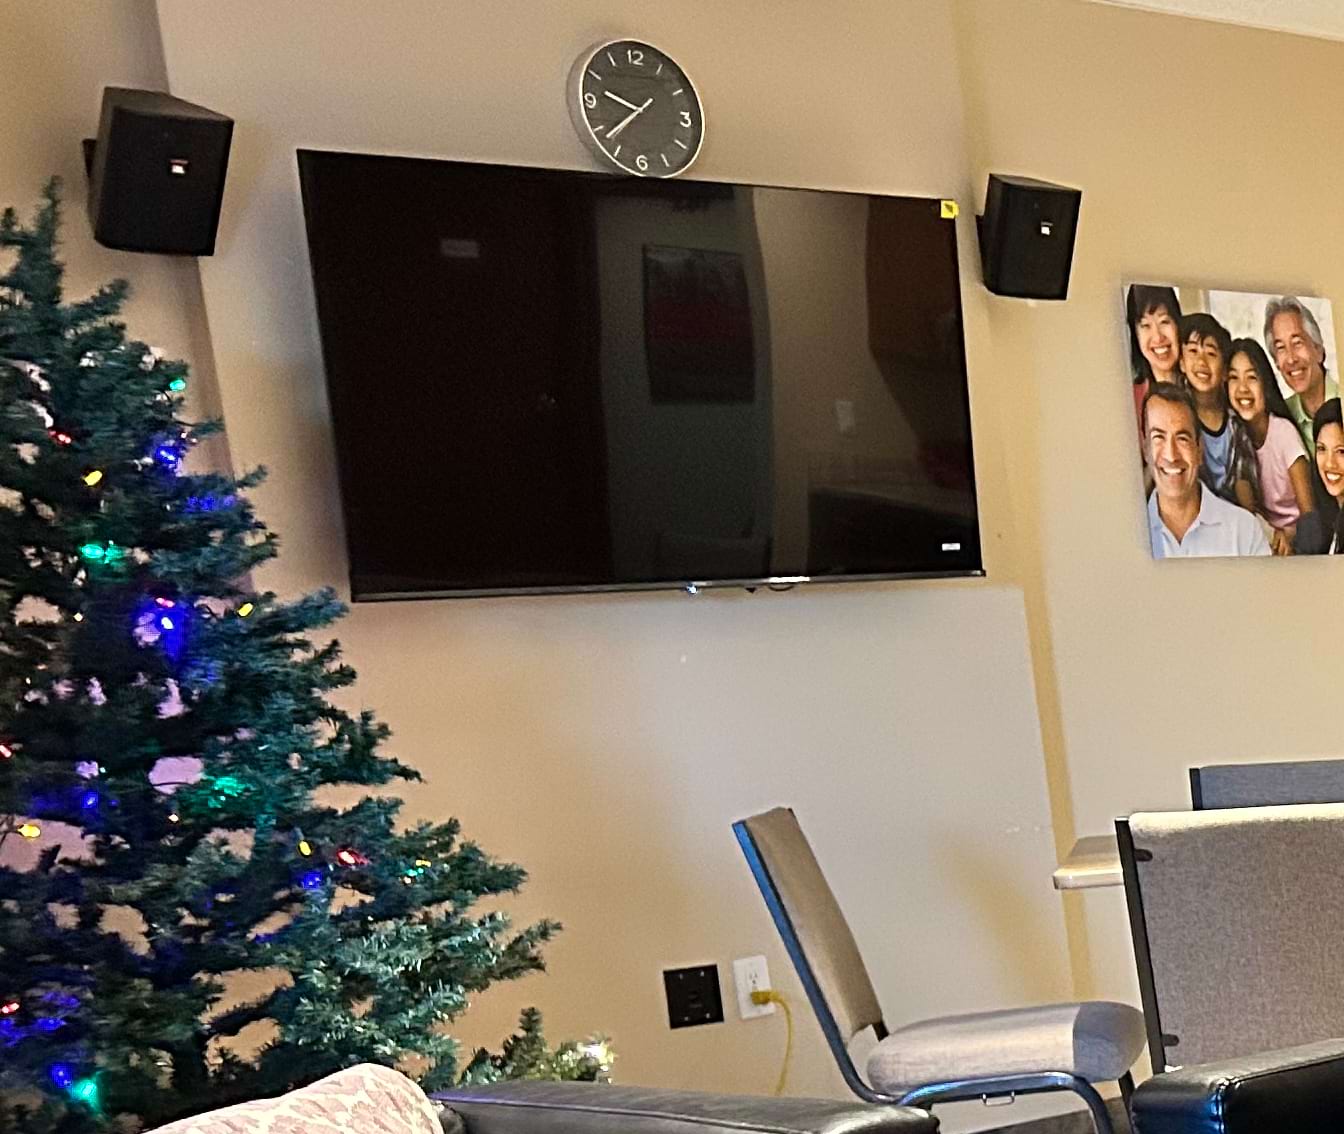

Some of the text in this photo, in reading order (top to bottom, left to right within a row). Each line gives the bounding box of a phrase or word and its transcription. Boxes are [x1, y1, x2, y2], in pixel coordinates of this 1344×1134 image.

[626, 49, 644, 66] 12
[583, 92, 597, 109] 9
[680, 111, 692, 128] 3
[635, 154, 649, 171] 6
